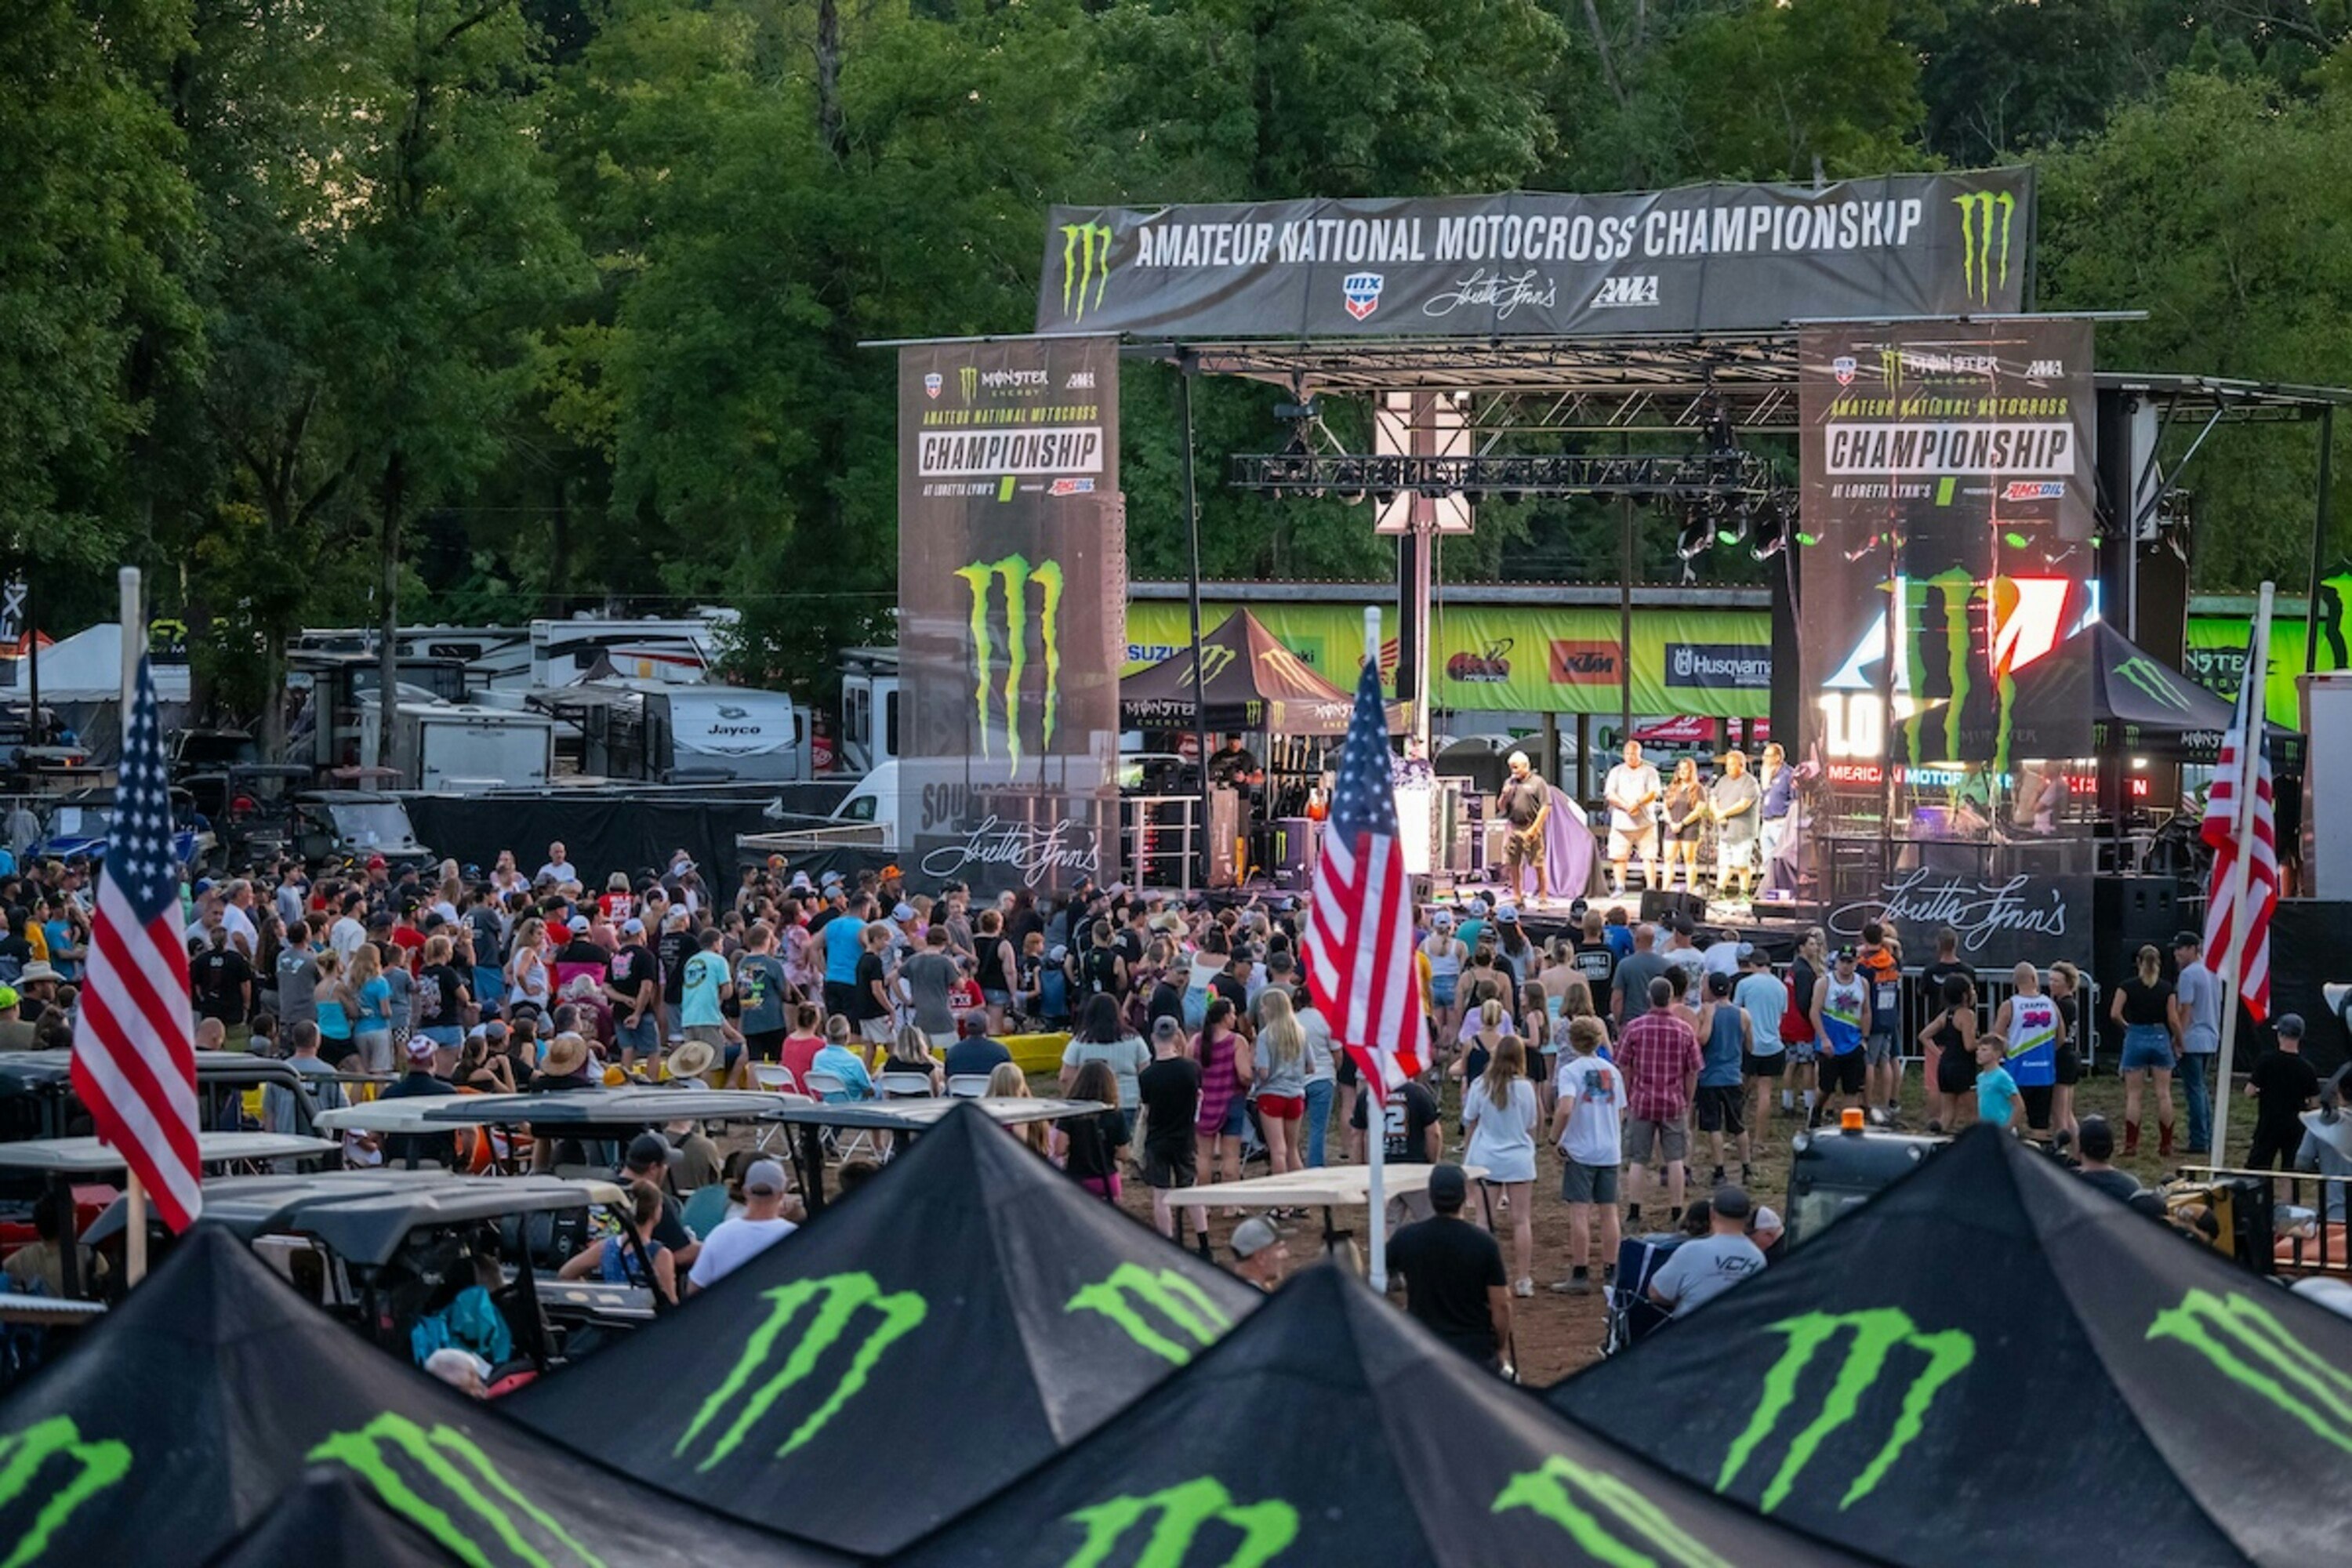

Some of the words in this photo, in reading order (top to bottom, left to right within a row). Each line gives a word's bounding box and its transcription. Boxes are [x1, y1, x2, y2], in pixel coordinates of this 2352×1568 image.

[1135, 223, 1274, 267] AMATEUR
[1279, 217, 1425, 263] NATIONAL
[1435, 215, 1635, 261] MOTOCROSS
[1644, 198, 1921, 257] CHAMPIONSHIP
[1591, 275, 1659, 307] AMA
[1910, 354, 2000, 375] MONSTER
[2024, 360, 2064, 378] AMA
[982, 368, 1049, 388] MONSTER
[1065, 372, 1095, 389] AMA
[923, 410, 970, 426] AMATEUR
[974, 408, 1025, 424] NATIONAL
[1031, 405, 1098, 423] MOTOCROSS
[1831, 400, 1893, 416] AMATEUR
[1900, 398, 1969, 416] NATIONAL
[1978, 397, 2068, 416] MOTOCROSS
[923, 433, 1097, 470] CHAMPIONSHIP
[1831, 429, 2067, 470] CHAMPIONSHIP
[1831, 484, 1843, 499] AT
[1845, 484, 1890, 499] LORETTA
[1563, 652, 1613, 673] KTM
[708, 724, 760, 736] Jayco
